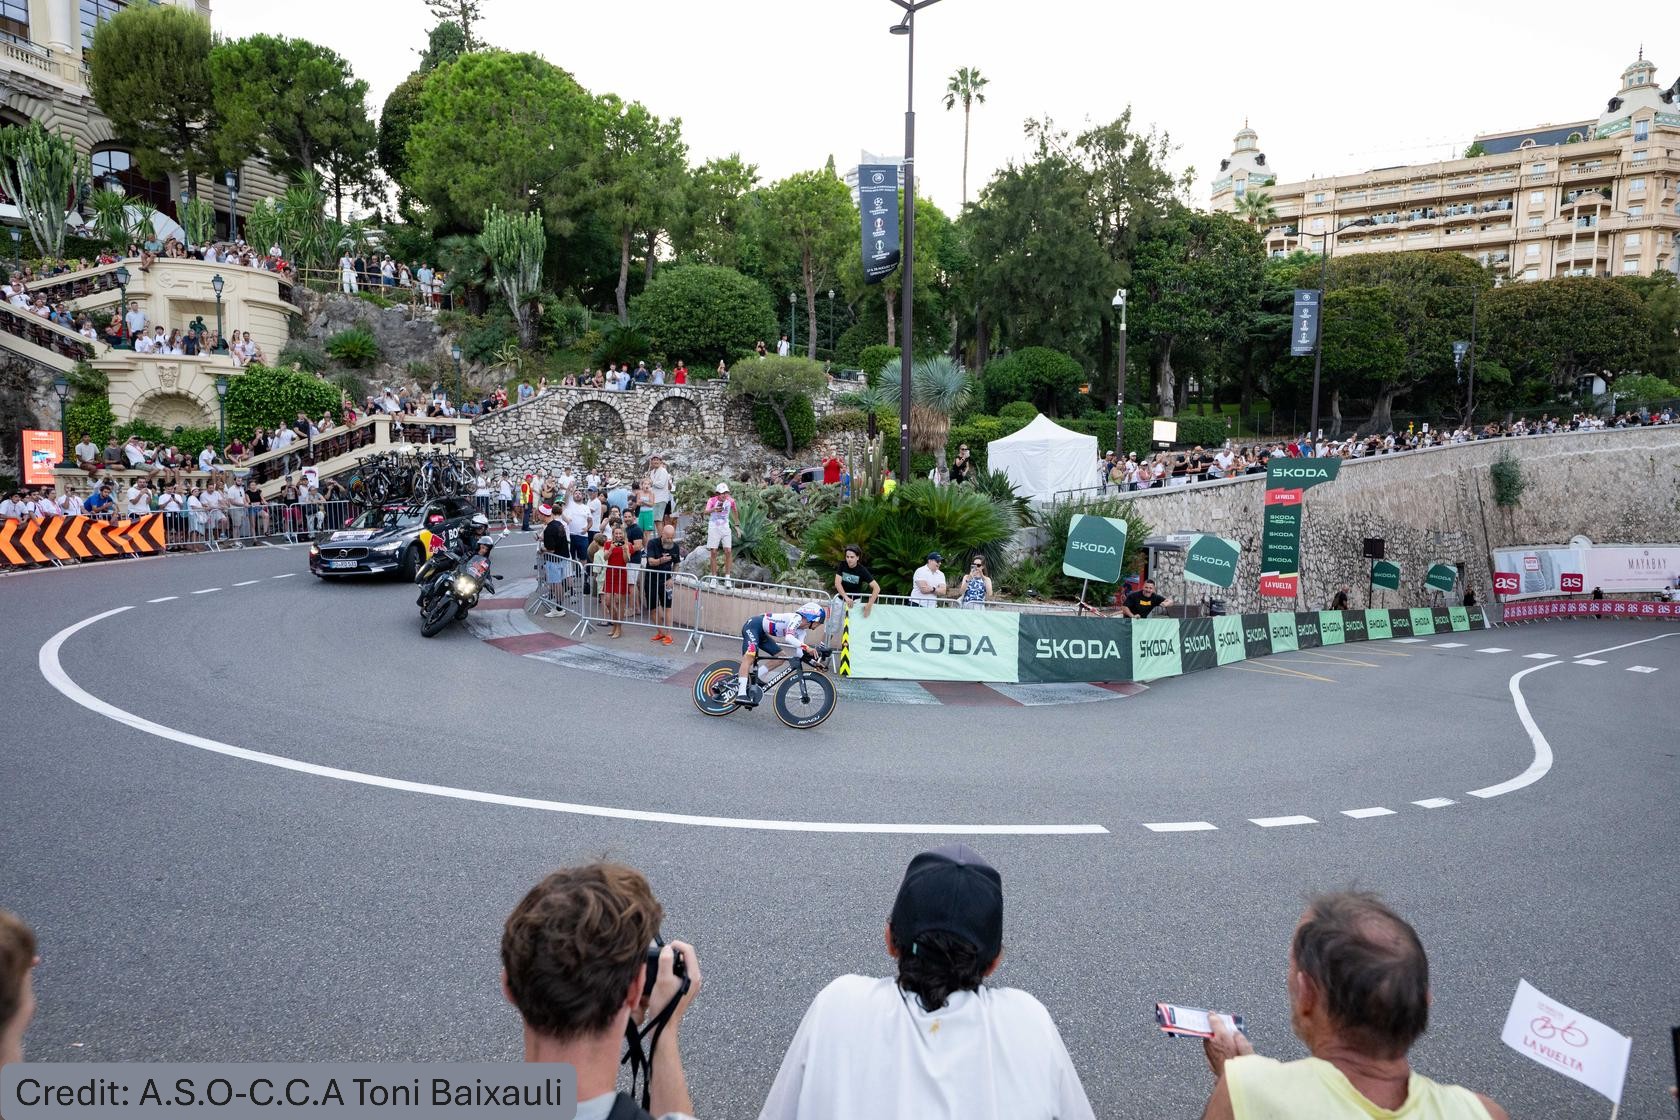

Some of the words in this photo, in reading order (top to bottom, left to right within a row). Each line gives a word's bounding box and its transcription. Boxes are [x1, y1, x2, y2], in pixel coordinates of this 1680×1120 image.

[1272, 582, 1292, 590] VUELTA
[1495, 577, 1518, 589] as
[1562, 577, 1581, 588] as
[1589, 603, 1600, 612] as
[1602, 602, 1612, 612] as
[1614, 603, 1625, 612] as
[1627, 603, 1638, 613] as
[1642, 604, 1654, 614] as
[1658, 604, 1671, 614] as
[1523, 1035, 1537, 1051] LA
[1539, 1044, 1583, 1072] VUELTA
